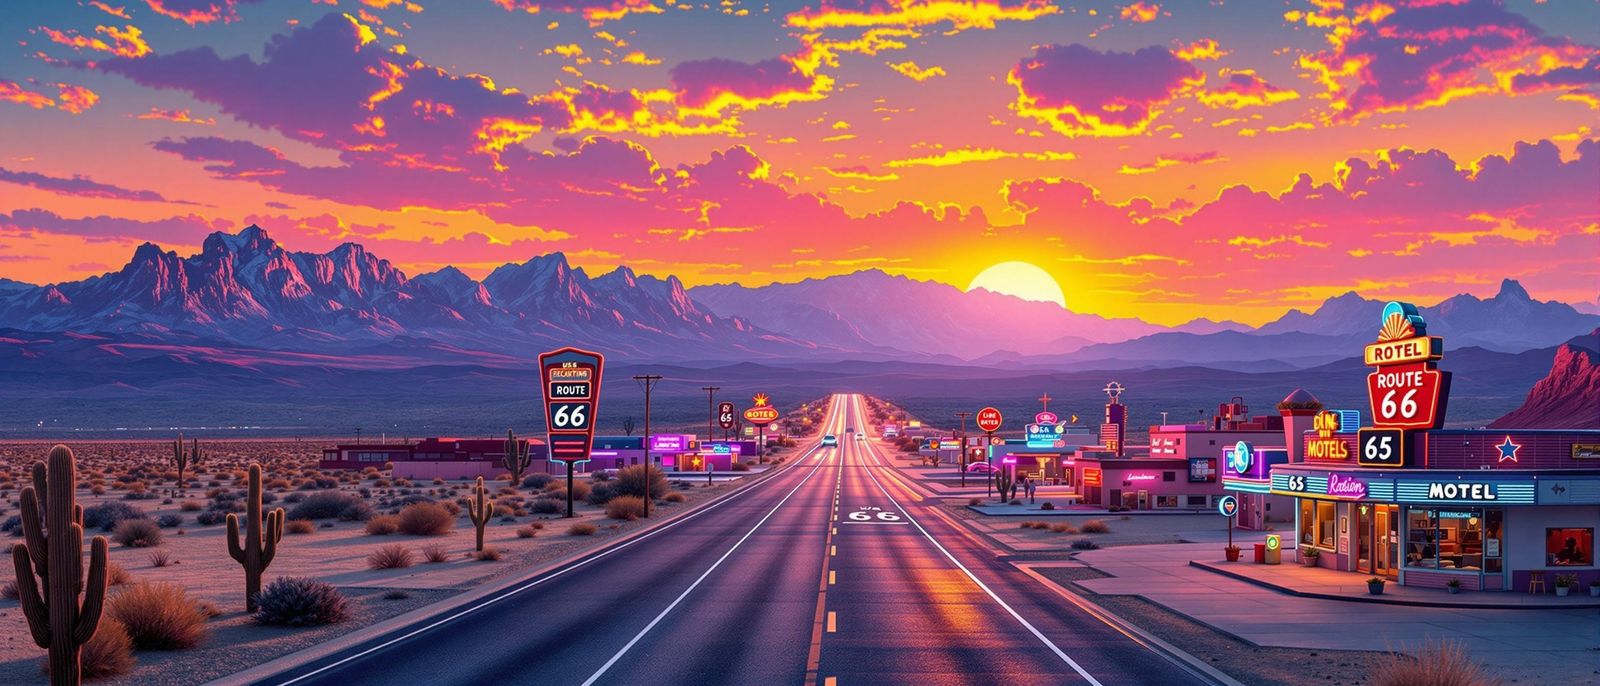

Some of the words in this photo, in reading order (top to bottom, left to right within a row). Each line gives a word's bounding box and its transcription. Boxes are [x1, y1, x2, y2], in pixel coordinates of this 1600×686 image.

[1374, 342, 1422, 360] ROTEL
[1377, 371, 1423, 388] ROUTE
[556, 385, 586, 395] ROUTE
[1381, 389, 1417, 419] 66
[554, 404, 585, 427] 66
[720, 412, 732, 422] 65
[1308, 440, 1348, 459] MOTELS
[1365, 436, 1392, 460] 65
[1289, 475, 1304, 491] 65
[1429, 482, 1495, 500] MOTEL
[849, 511, 900, 521] 66
